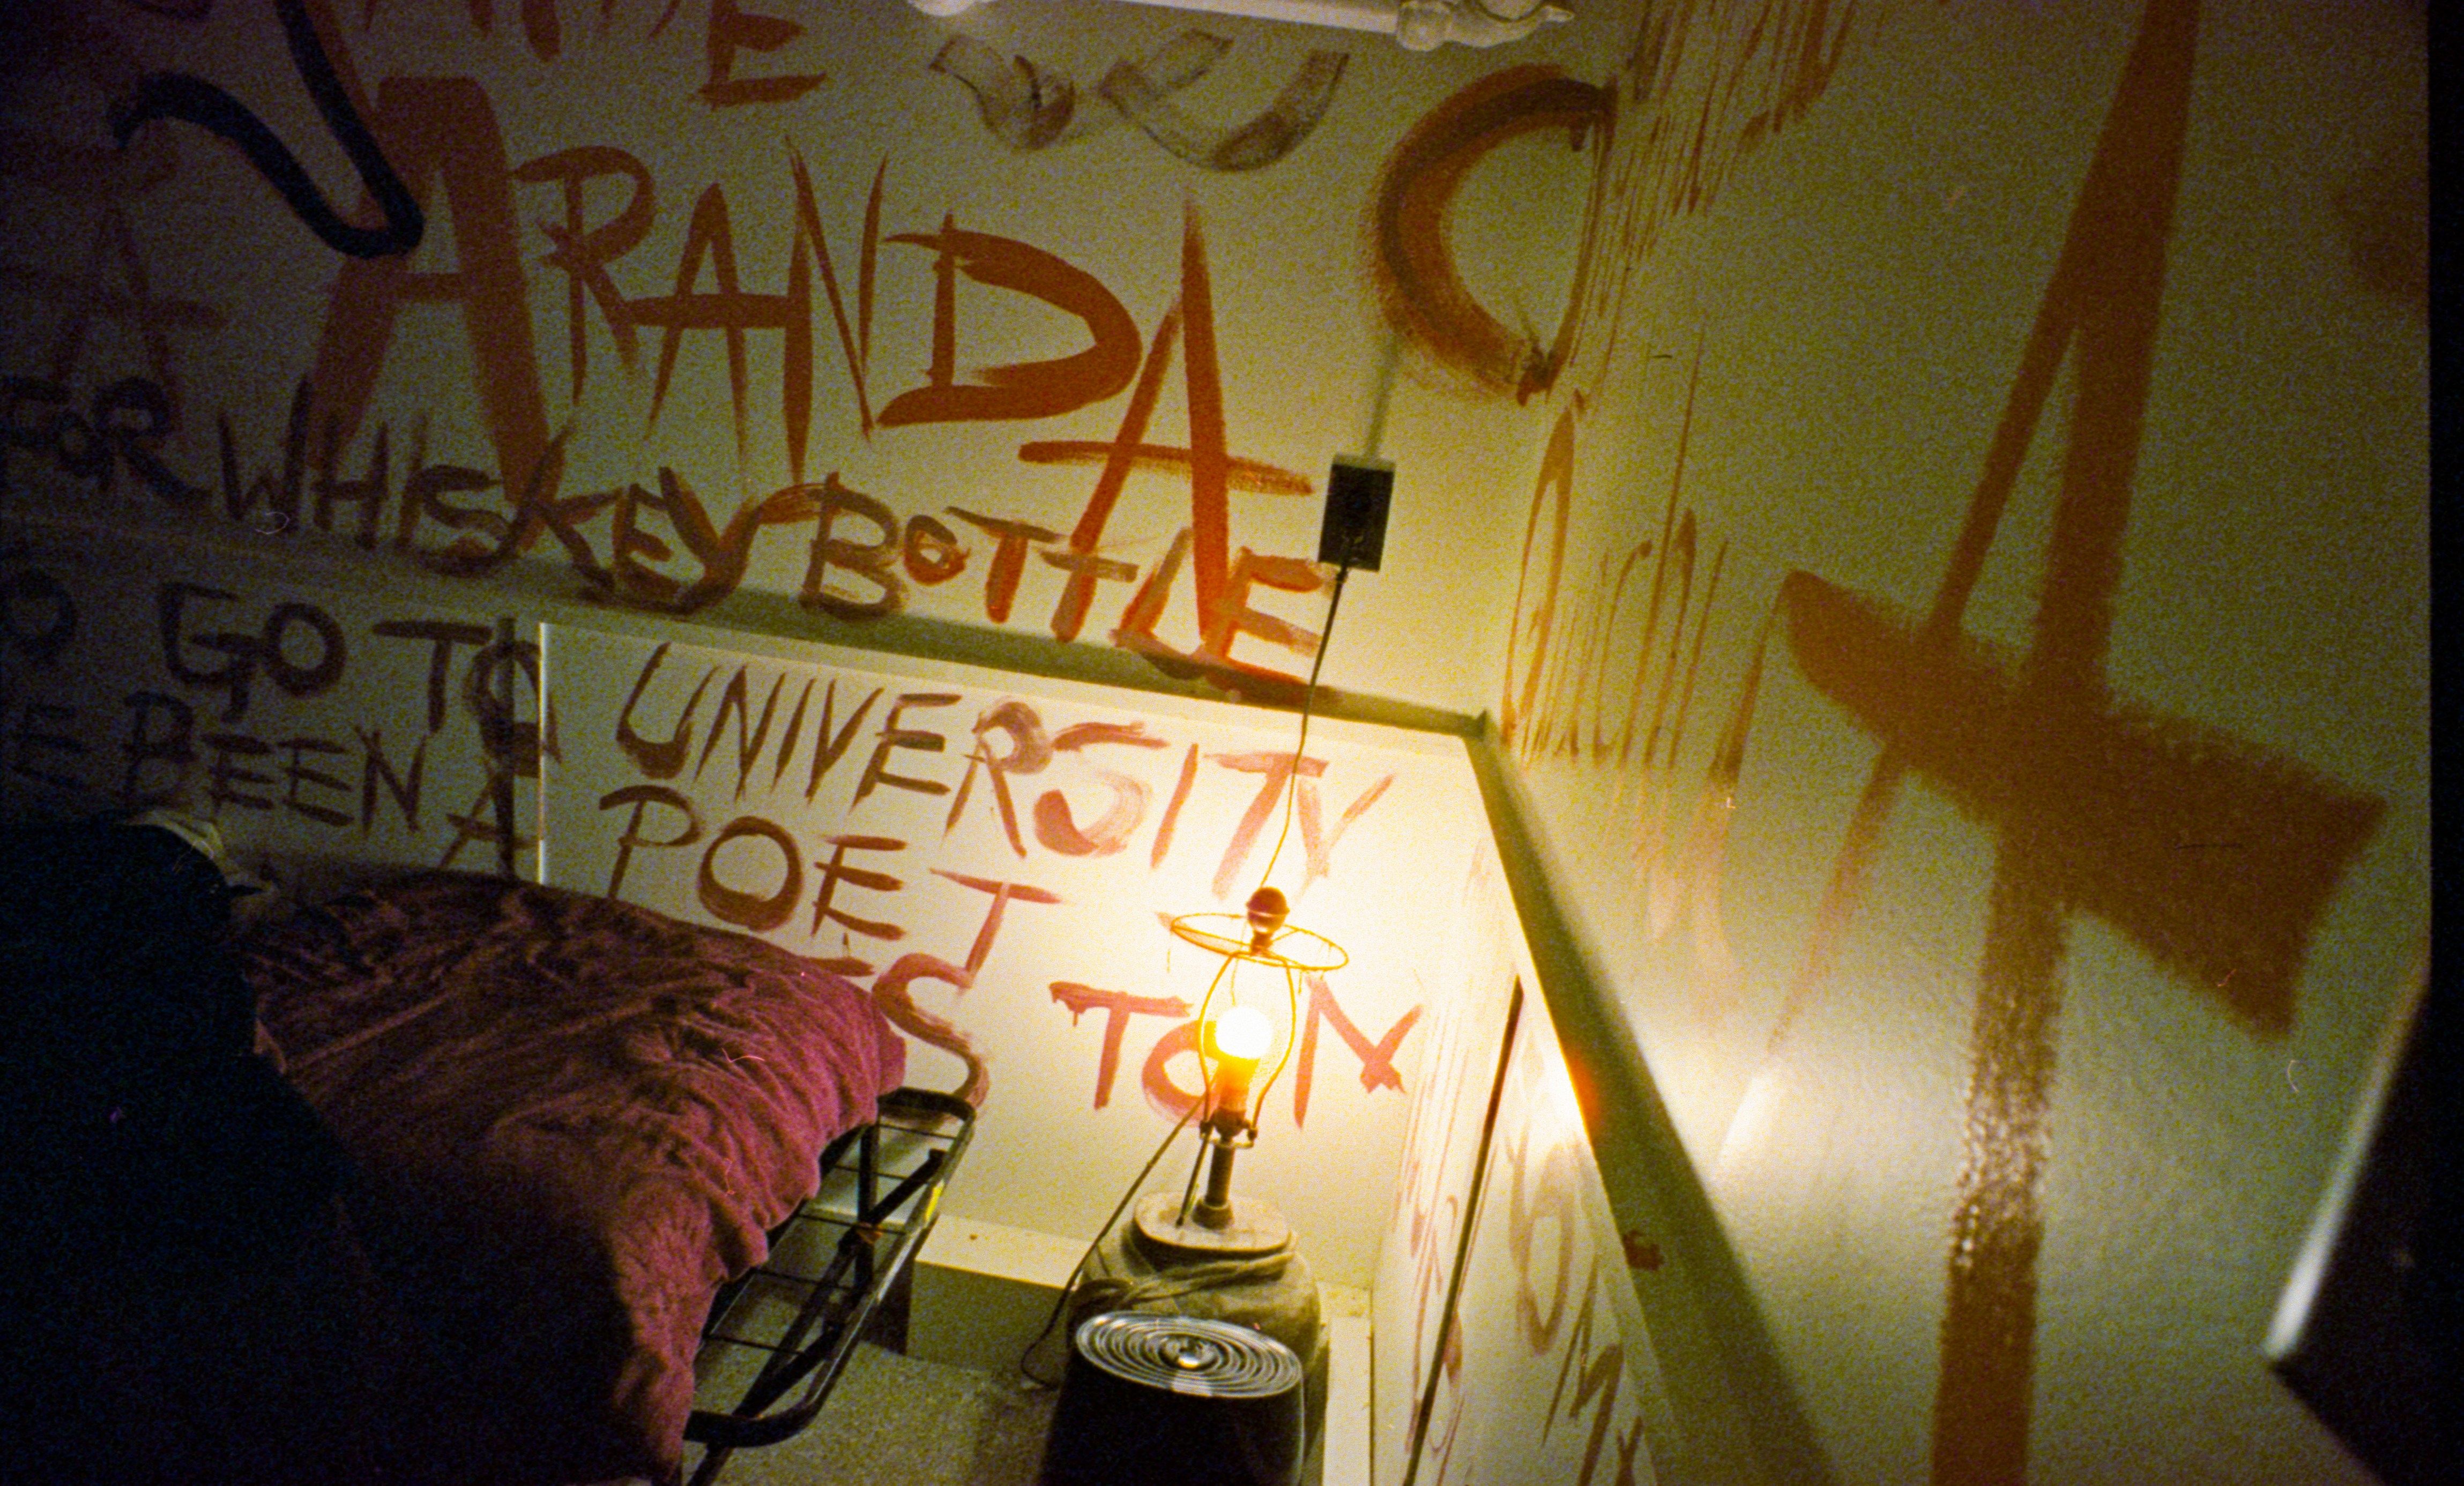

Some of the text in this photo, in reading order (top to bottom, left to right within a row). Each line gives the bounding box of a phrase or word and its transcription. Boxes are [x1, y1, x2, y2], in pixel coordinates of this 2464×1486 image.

[799, 472, 1340, 705] BOTTLE
[158, 581, 347, 722] GO
[615, 643, 1396, 906] UNIVERSITY
[599, 784, 1067, 989] POET
